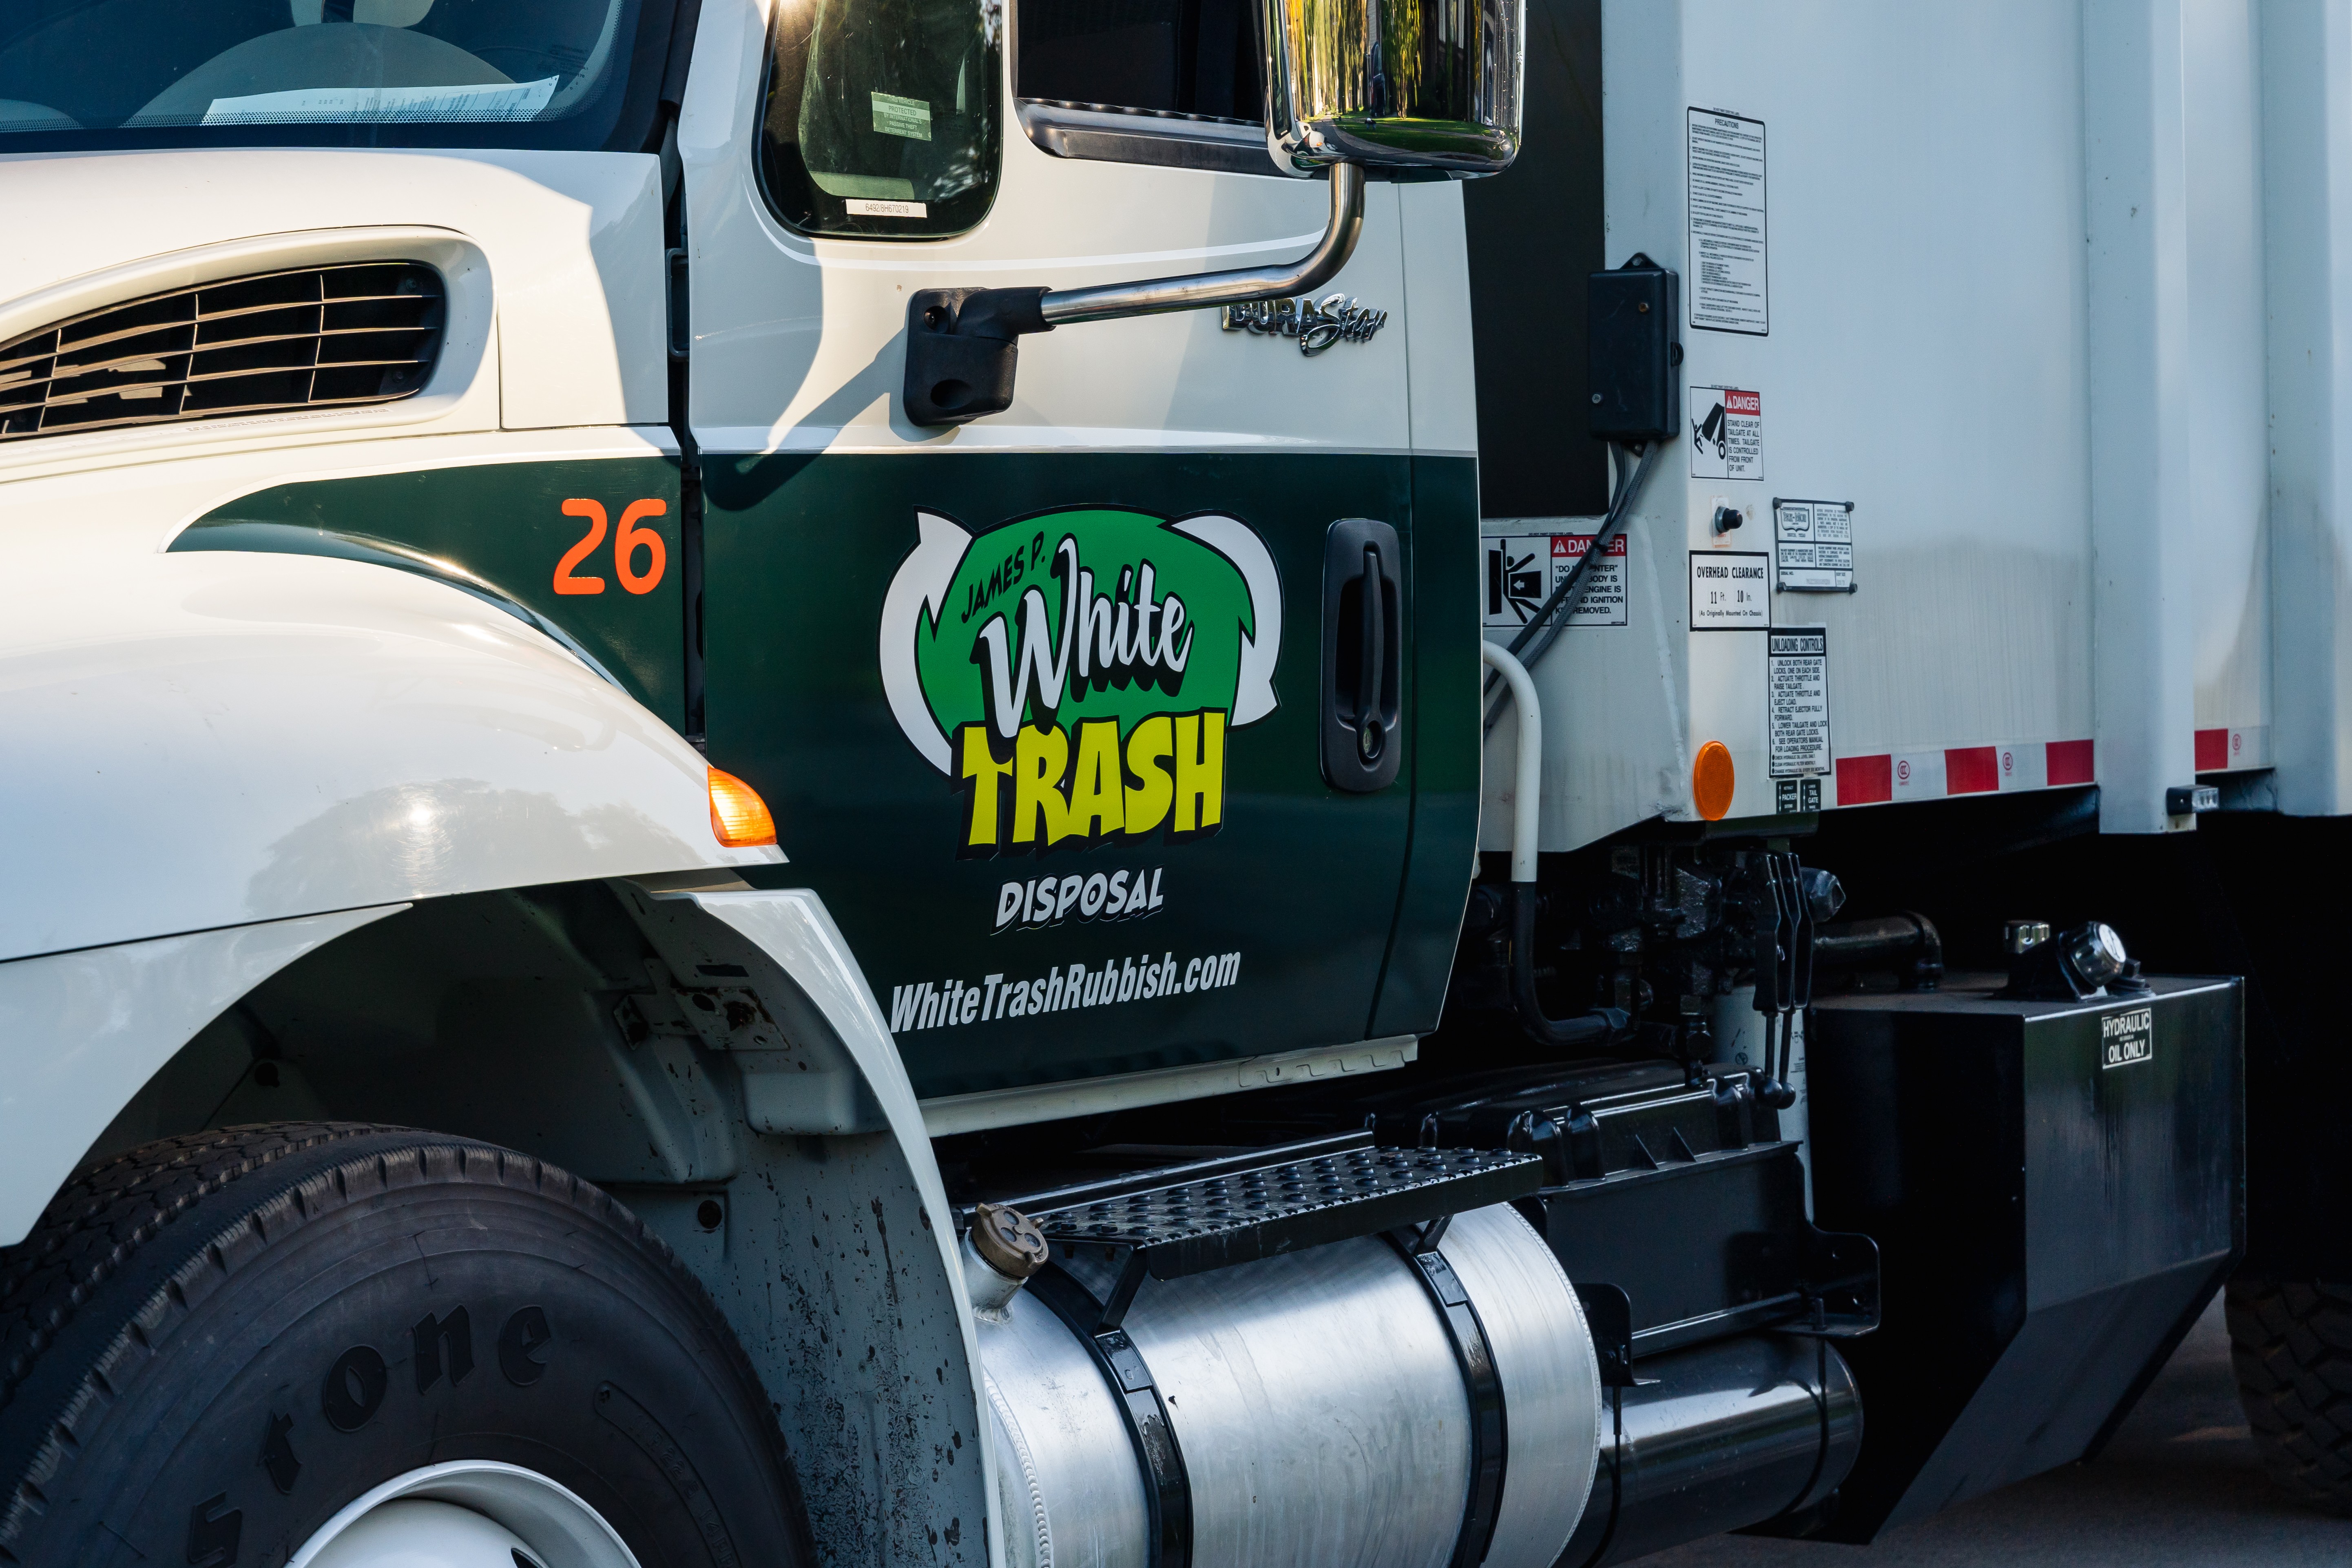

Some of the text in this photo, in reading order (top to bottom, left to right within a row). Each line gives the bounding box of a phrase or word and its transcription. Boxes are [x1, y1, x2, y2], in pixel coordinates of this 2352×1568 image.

[889, 106, 916, 115] PROTECTED
[889, 114, 922, 124] INTERNATIONAL'S
[1715, 118, 1739, 129] PRECAUTIONS
[885, 127, 907, 135] DETERRENT
[865, 203, 909, 213] 6492/8H670219
[1733, 396, 1759, 411] DANGER
[553, 498, 666, 595] 26
[1568, 539, 1624, 553] DANER
[962, 531, 1046, 623] JAMES P.
[1697, 566, 1763, 579] OVERHEAD CLEARANCE
[1711, 591, 1717, 604] 11
[1737, 590, 1744, 603] 10
[977, 537, 1193, 739] White
[1772, 638, 1823, 652] UNLOADING CONTROLS
[962, 711, 1226, 847] TRASH
[996, 867, 1164, 929] DISPOSAL
[890, 951, 1241, 1033] WhiteTrashRubbish.com
[2103, 1012, 2150, 1038] HYDRAULIC
[2109, 1039, 2145, 1063] OIL ONLY
[186, 1305, 553, 1568] stone
